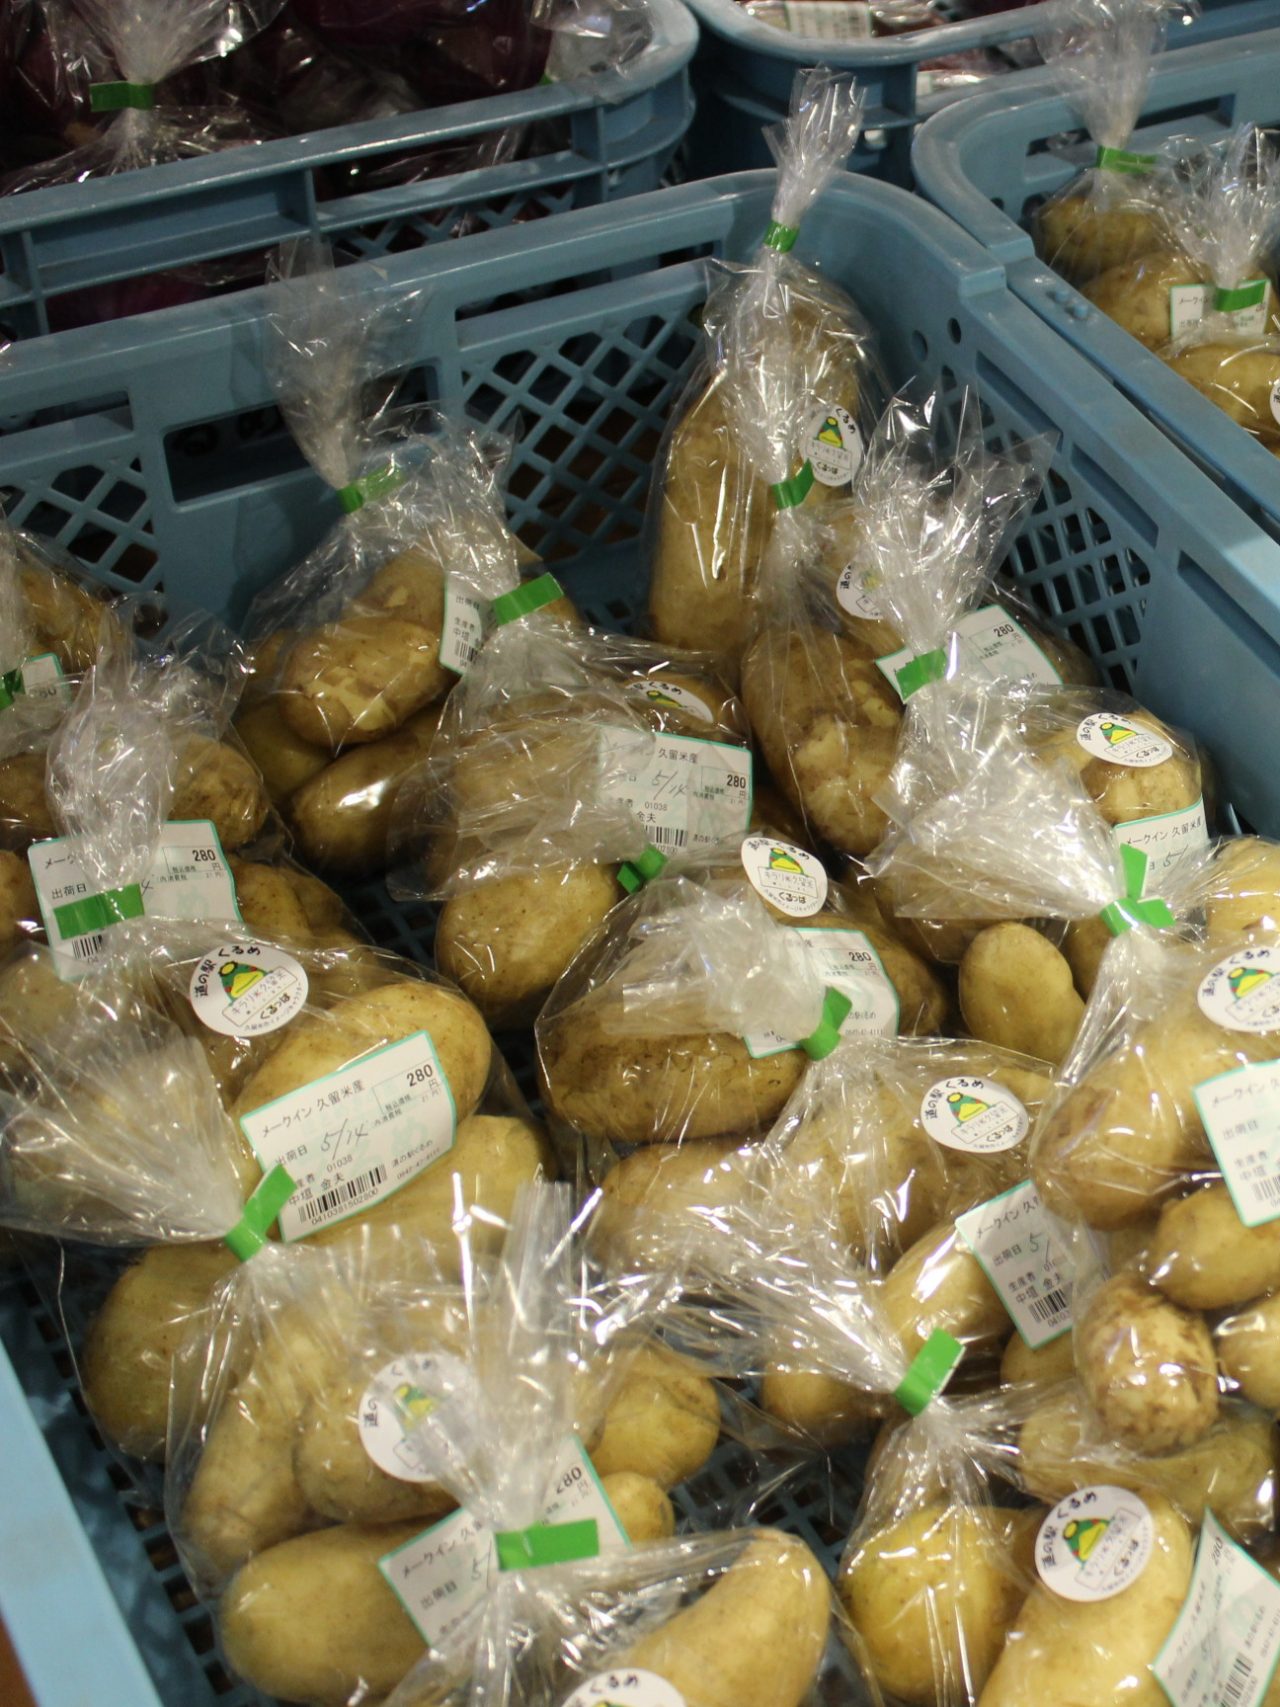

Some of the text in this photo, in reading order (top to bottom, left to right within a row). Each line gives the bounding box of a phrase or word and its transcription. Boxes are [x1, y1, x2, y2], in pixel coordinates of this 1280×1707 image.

[993, 623, 1015, 639] 280
[647, 680, 683, 696] くるめ
[1080, 718, 1097, 742] 道の駅
[657, 747, 699, 764] 久留米産
[651, 770, 690, 801] 5/14
[726, 774, 747, 789] 280
[644, 801, 668, 811] 01038
[1126, 830, 1169, 847] メークイン
[191, 849, 217, 862] 280
[211, 862, 222, 872] 円
[50, 882, 87, 900] 出荷日
[848, 951, 872, 962] 280
[194, 945, 262, 999] 道の駅 くるめ
[1202, 967, 1224, 997] 道の駅
[1228, 949, 1270, 965] くるめ
[405, 1063, 434, 1089] 280
[428, 1078, 440, 1091] 円
[924, 1078, 985, 1120] 道の駅 くるめ
[1211, 1082, 1266, 1108] メークイン
[262, 1079, 366, 1139] メークイン 久留米産
[320, 1118, 369, 1161] 5/14
[1222, 1118, 1259, 1140] 出荷日
[275, 1144, 308, 1167] 出荷日
[325, 1154, 354, 1173] 01038
[1234, 1149, 1268, 1168] 生産者
[1239, 1165, 1268, 1182] 中垣
[288, 1171, 345, 1207] 中垣 金夫
[975, 1209, 1020, 1241] メークイン
[992, 1243, 1023, 1267] 出荷日
[1007, 1270, 1037, 1293] 生産者
[1015, 1284, 1040, 1305] 中垣
[1041, 1490, 1098, 1571] 道の駅 くるめ
[403, 1538, 457, 1579] メークイン
[420, 1580, 458, 1608] 出荷日
